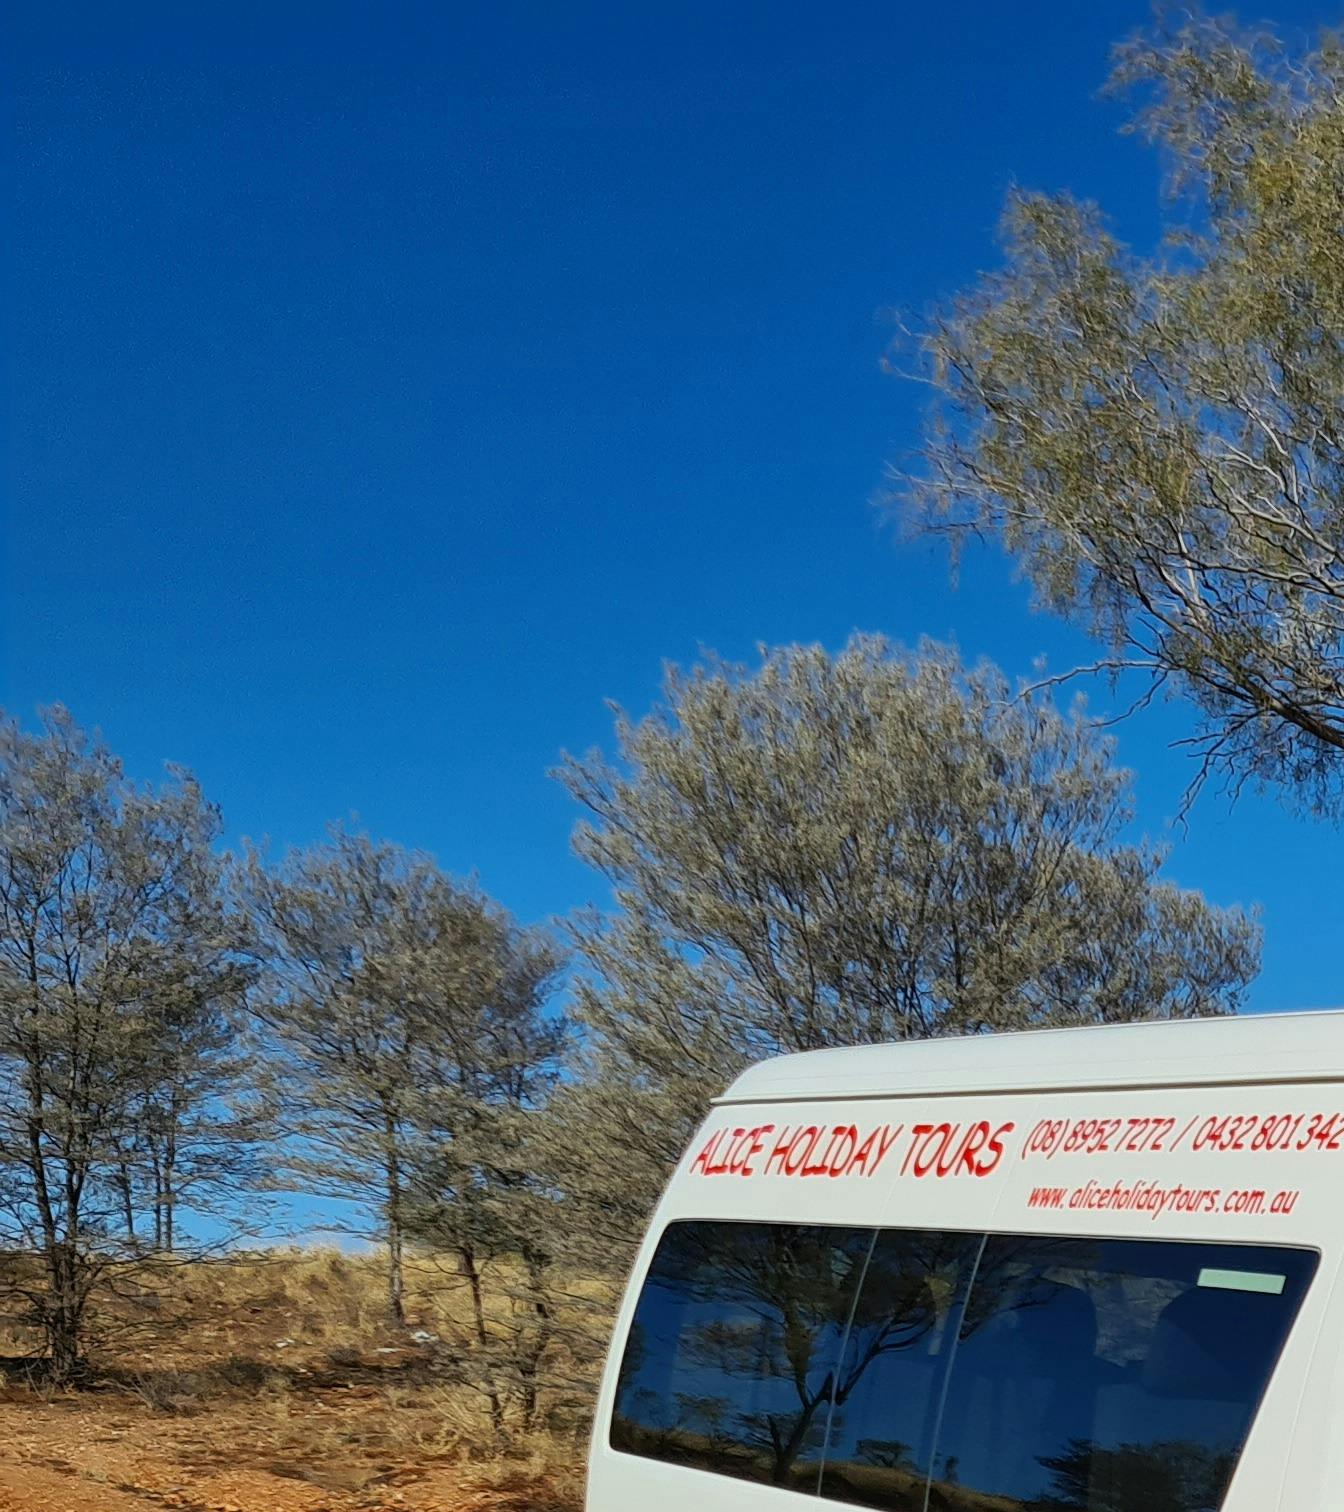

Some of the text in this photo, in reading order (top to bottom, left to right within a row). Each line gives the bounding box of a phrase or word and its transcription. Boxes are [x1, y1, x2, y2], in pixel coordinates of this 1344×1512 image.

[689, 1120, 1015, 1178] ALICE HOLIDAY TOURS
[1021, 1118, 1071, 1160] (08)
